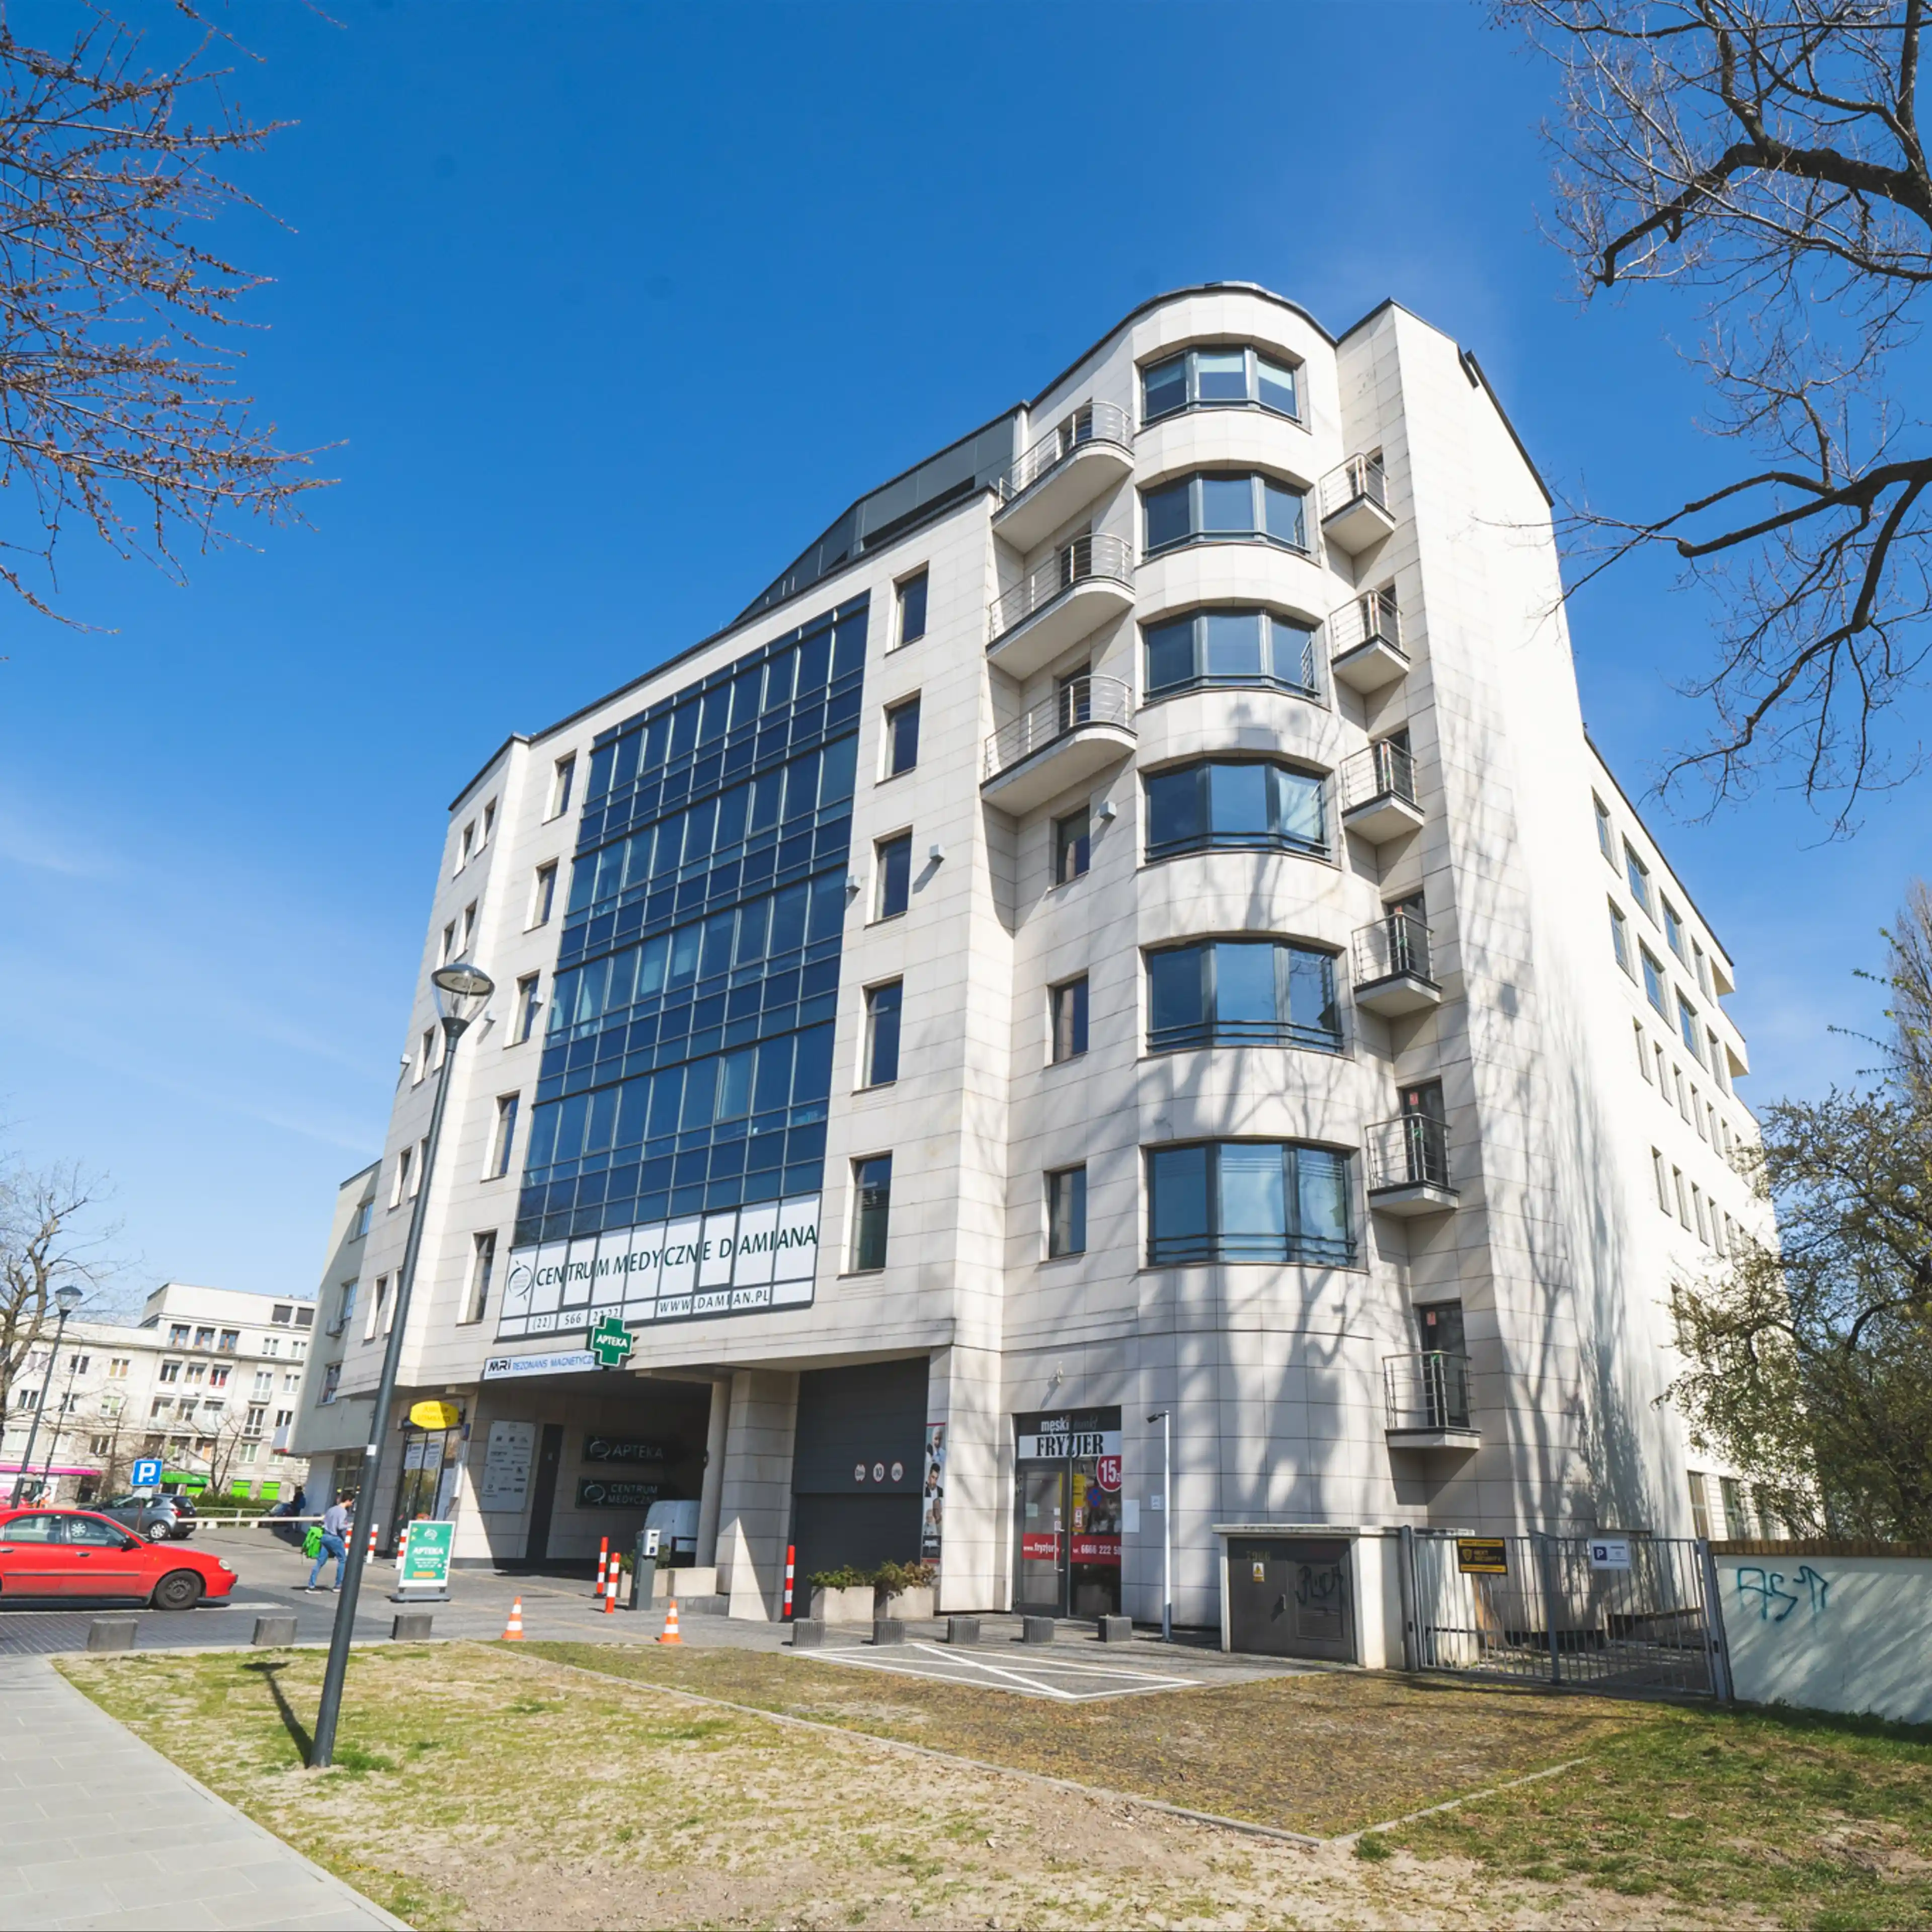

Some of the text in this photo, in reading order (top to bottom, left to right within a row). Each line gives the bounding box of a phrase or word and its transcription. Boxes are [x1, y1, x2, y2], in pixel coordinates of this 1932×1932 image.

[537, 1225, 817, 1286] CENTRUM MEDYCZNE DAMIANA
[660, 1290, 768, 1312] WWW.DAMIAN.PL
[532, 1316, 551, 1330] (22)
[565, 1313, 581, 1325] 566
[596, 1335, 628, 1347] APTEKA
[550, 1355, 594, 1367] MAGNETYCZ
[1041, 1417, 1069, 1435] męski
[612, 1444, 664, 1459] APTEKA
[1036, 1433, 1103, 1459] FRYZJER
[1101, 1460, 1117, 1482] 15
[611, 1484, 658, 1494] CENTRUM
